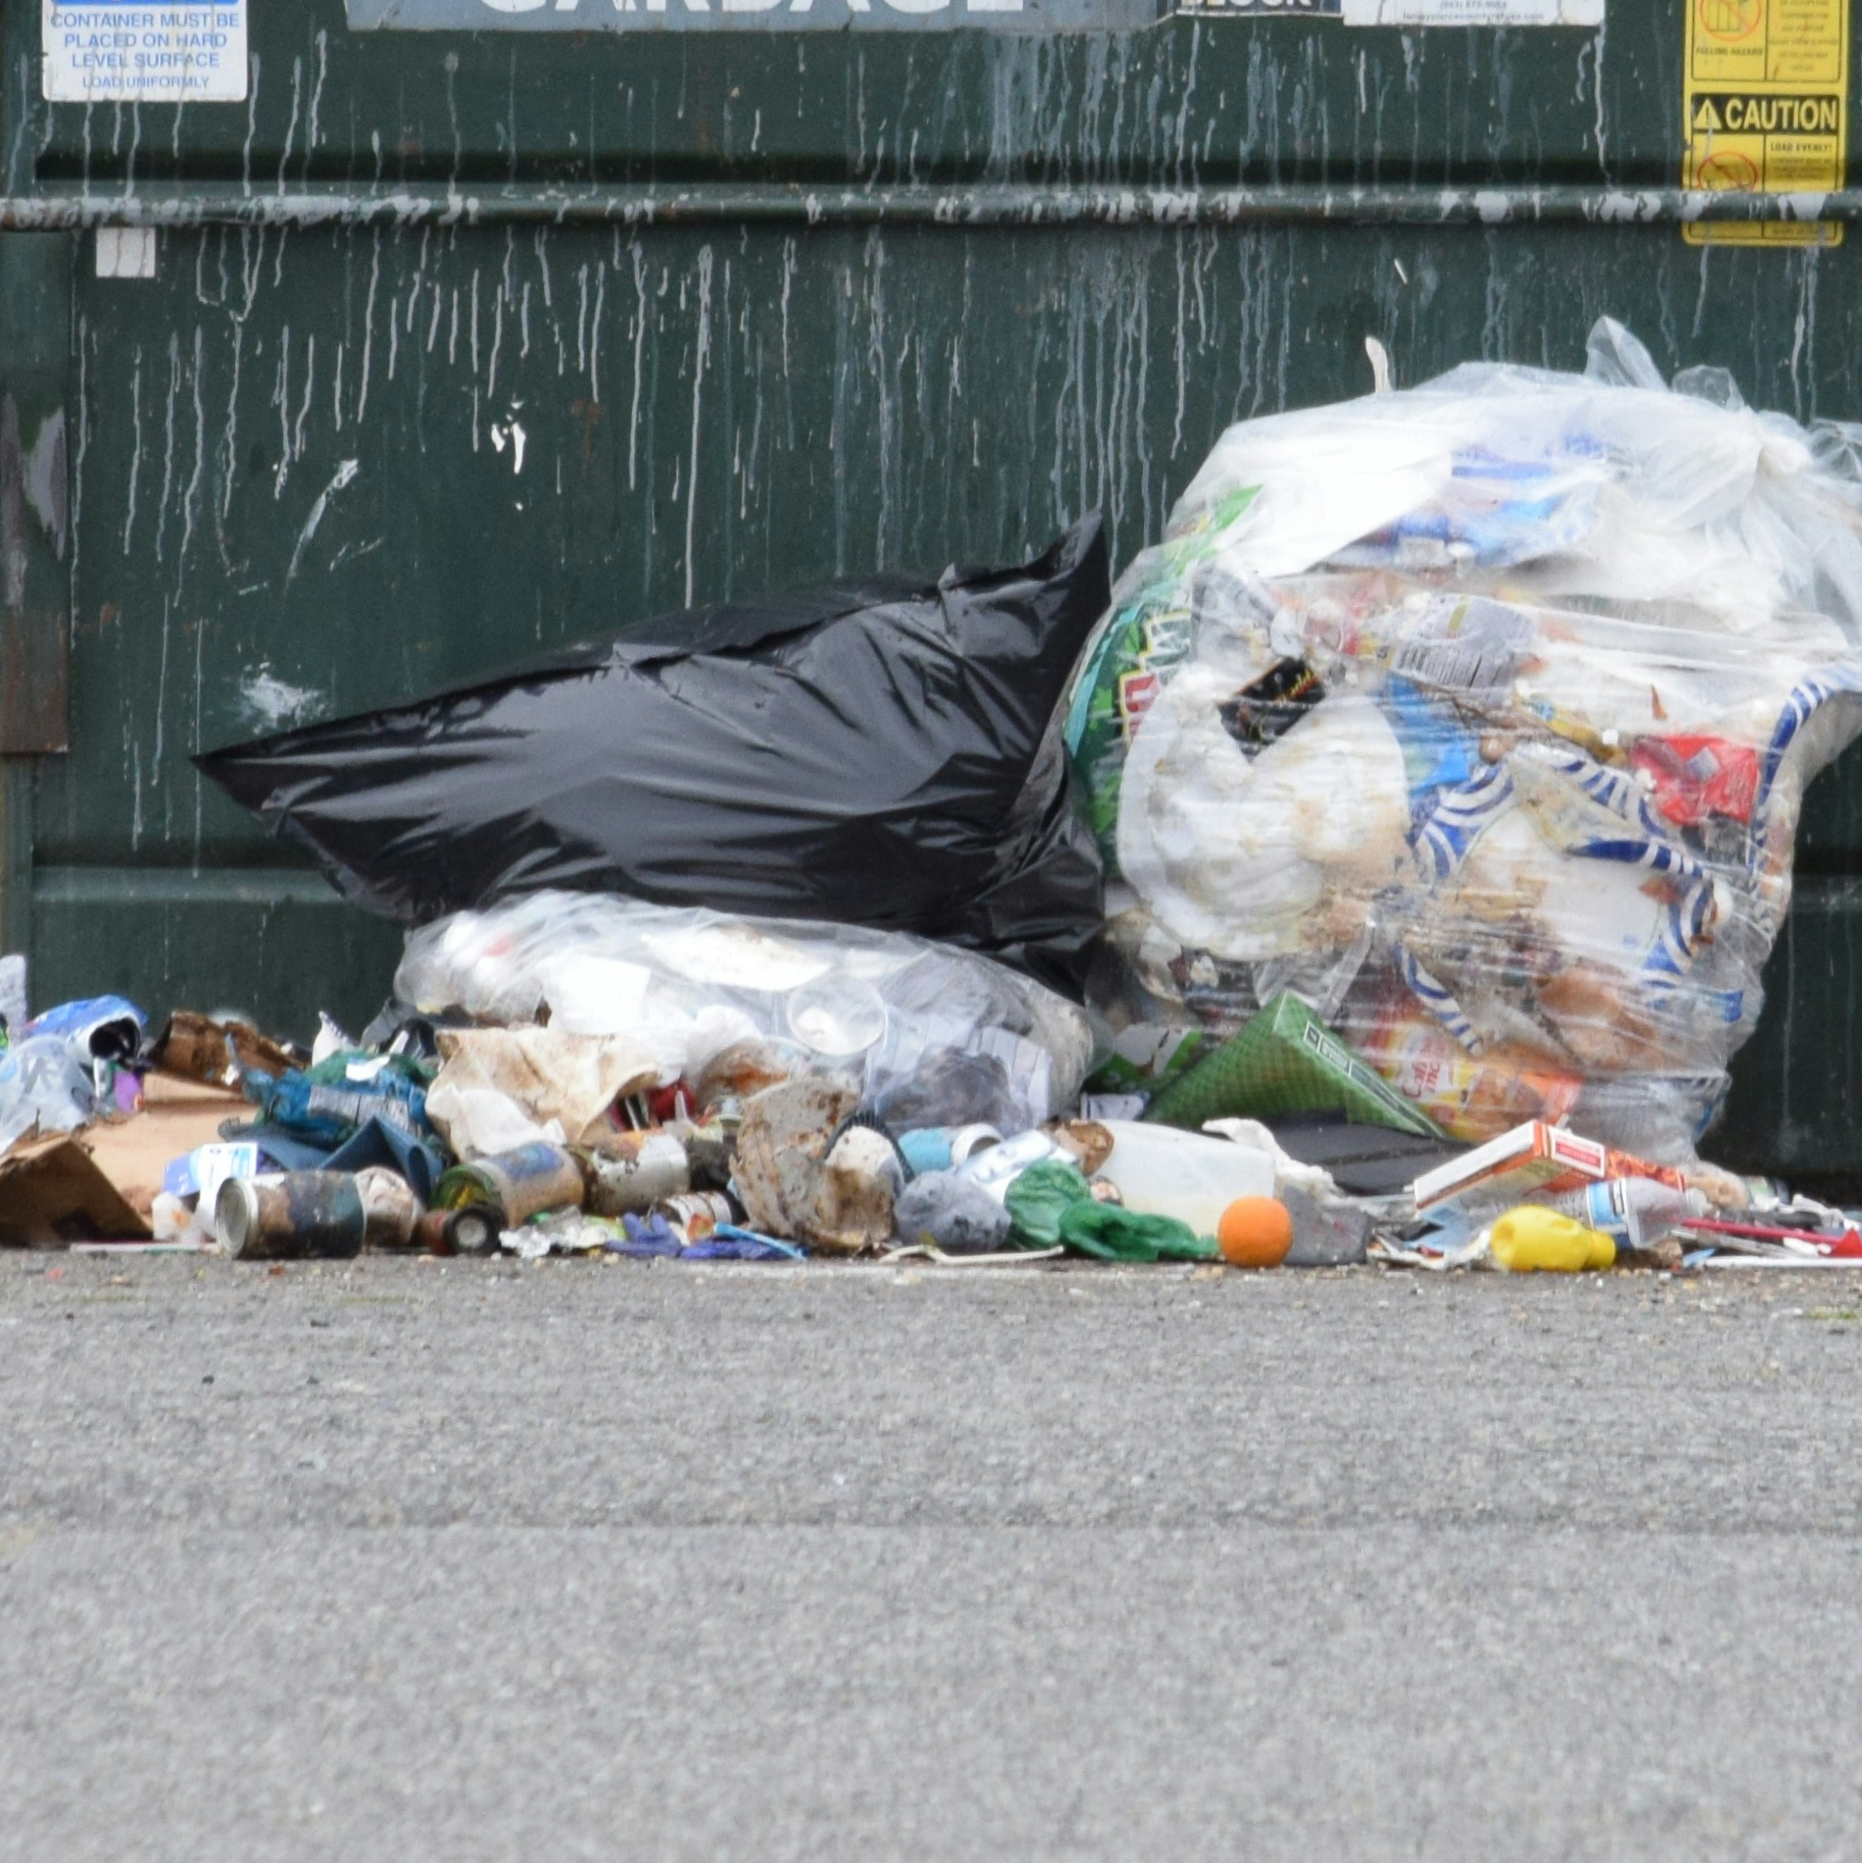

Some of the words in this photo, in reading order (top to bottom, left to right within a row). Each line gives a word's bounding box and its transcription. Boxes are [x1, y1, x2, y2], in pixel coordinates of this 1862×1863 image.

[51, 13, 154, 28] CONTAINER
[160, 13, 211, 28] MUST
[217, 13, 239, 28] BE
[64, 33, 137, 48] PLACED
[142, 33, 170, 48] ON
[176, 33, 227, 48] HARD
[72, 52, 129, 68] LEVEL
[133, 52, 220, 68] SURFACE
[82, 76, 122, 89] LOAD
[126, 75, 210, 89] UNIFORMLY
[1725, 98, 1837, 130] CAUTION
[1770, 141, 1793, 152] LOAD
